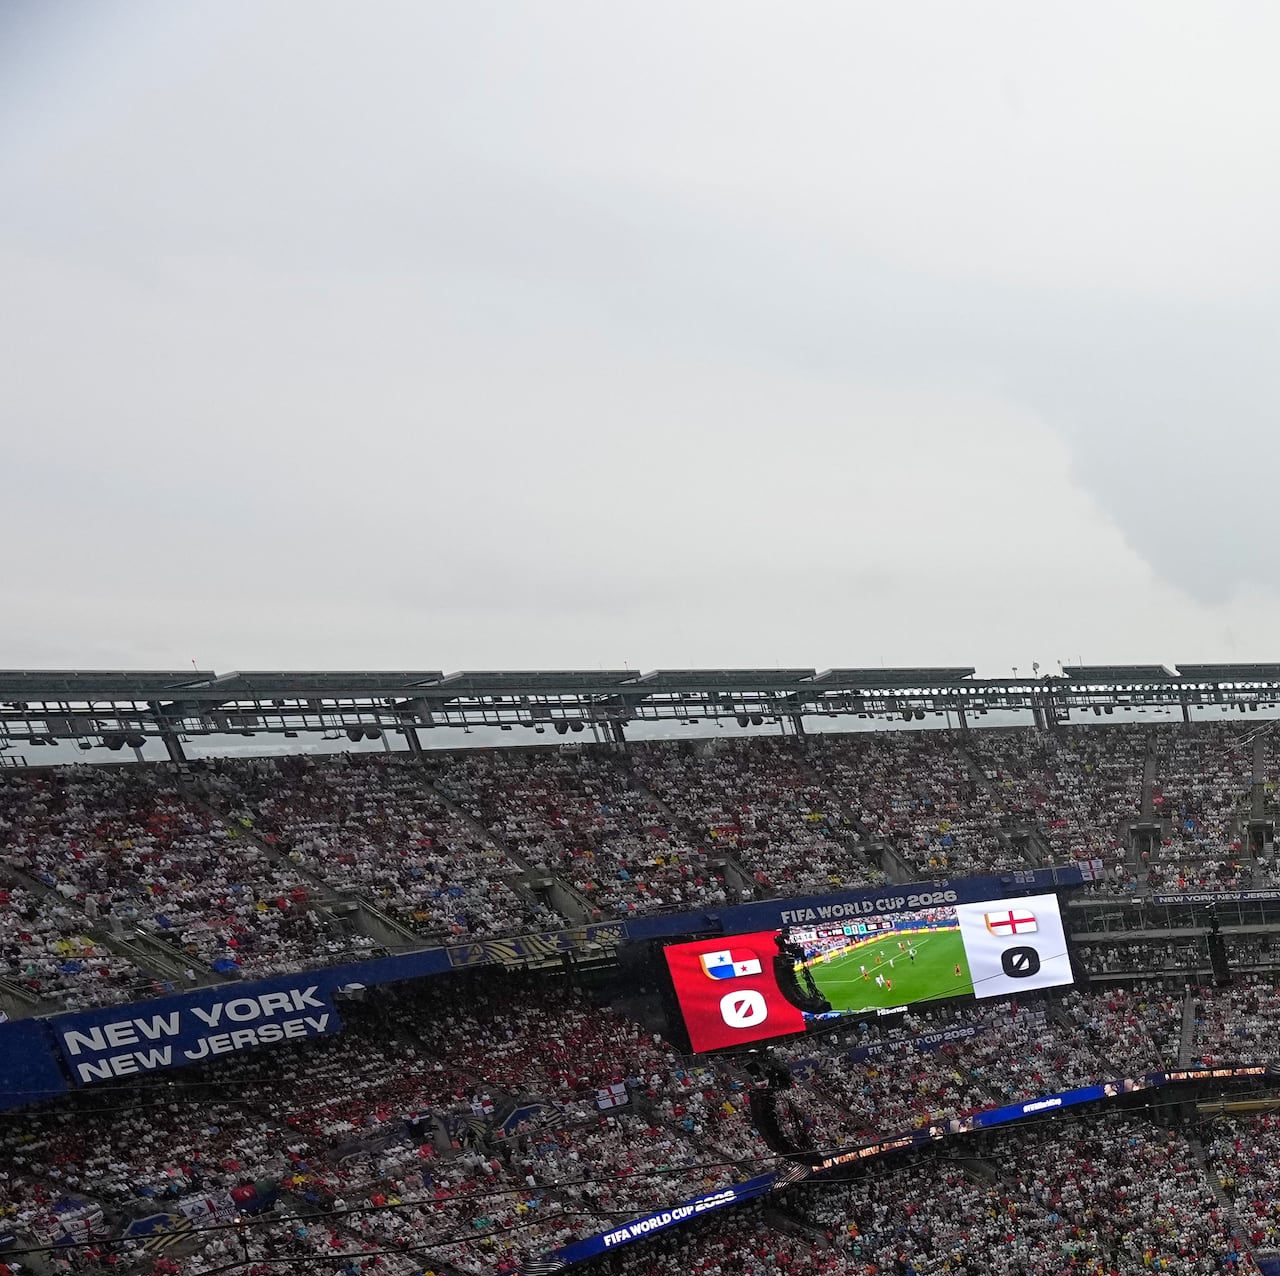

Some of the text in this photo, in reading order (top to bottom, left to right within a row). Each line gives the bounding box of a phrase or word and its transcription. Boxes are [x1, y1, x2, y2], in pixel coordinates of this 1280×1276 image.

[781, 890, 958, 924] FIFA WORLD CUP 2026
[1160, 895, 1184, 903] NEW
[1186, 893, 1216, 902] YORK
[1217, 892, 1242, 901] NEW
[64, 985, 326, 1055] NEW YORK
[877, 1005, 908, 1016] Hisense
[924, 1033, 943, 1044] CUP
[943, 1027, 976, 1041] 2026
[77, 1014, 330, 1083] NEW JERSEY
[859, 1145, 880, 1158] NEW
[603, 1190, 737, 1247] FIFA WORLD CUP 2026
